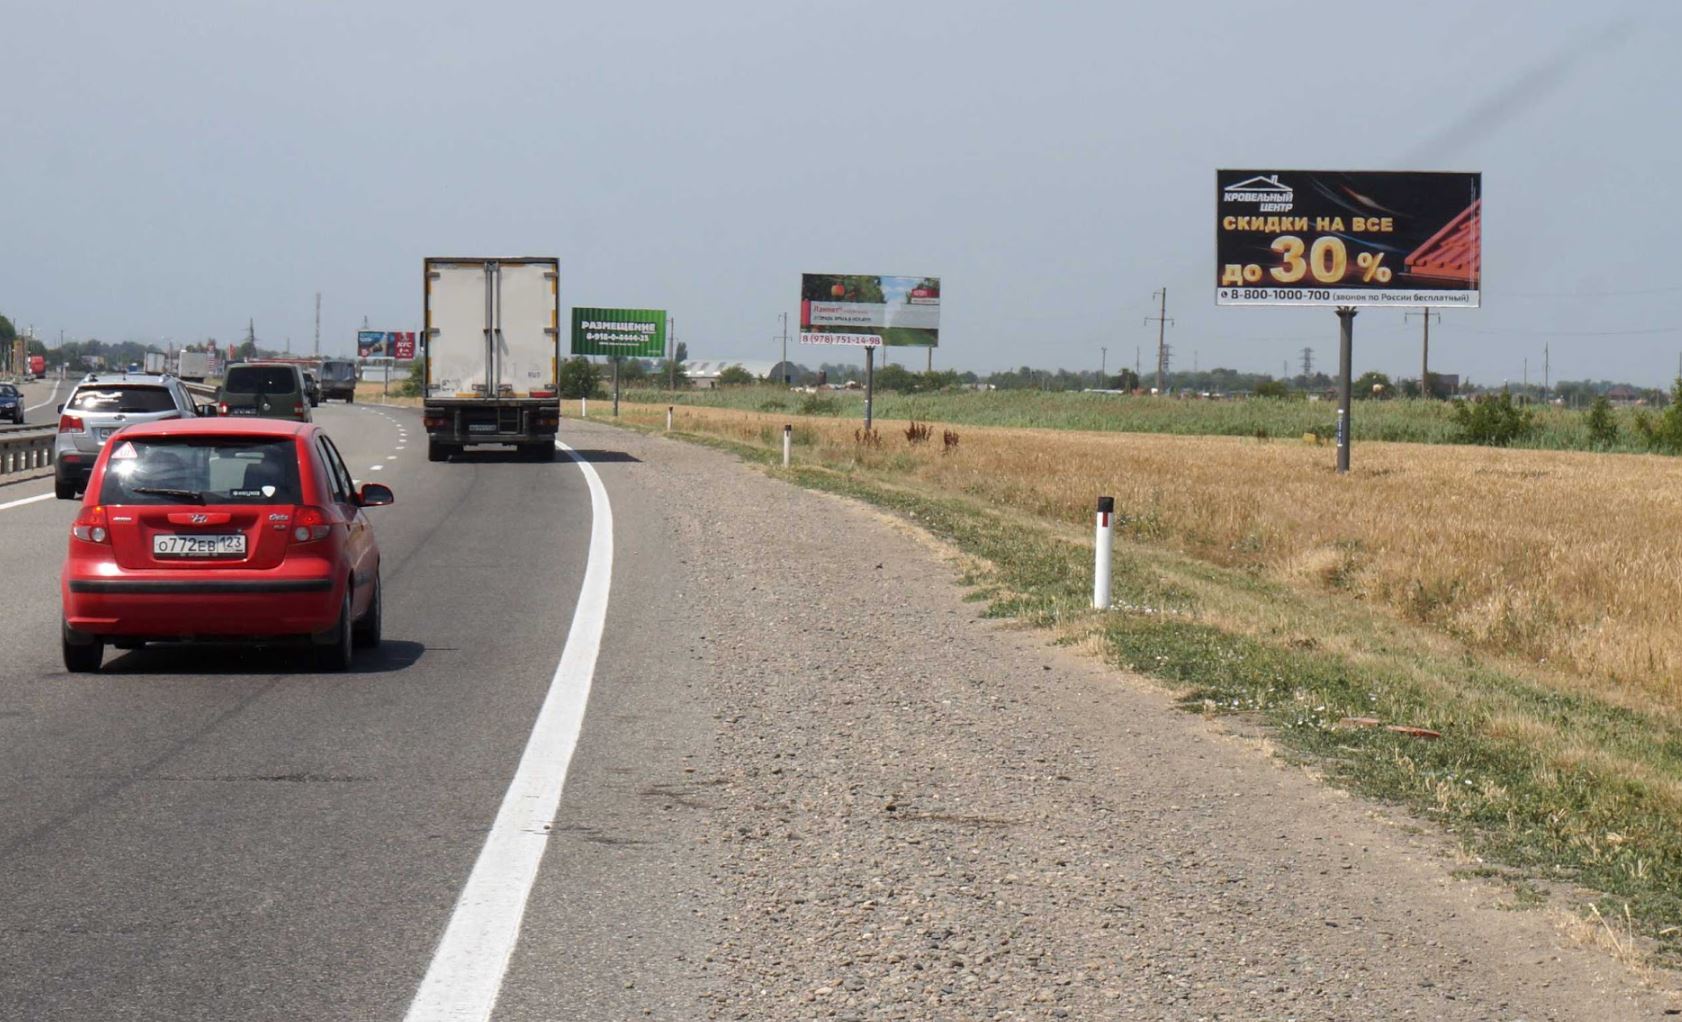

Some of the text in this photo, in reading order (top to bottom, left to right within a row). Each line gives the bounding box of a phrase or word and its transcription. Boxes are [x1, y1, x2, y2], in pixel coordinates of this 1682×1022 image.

[1224, 191, 1293, 202] КРОВЕЛЬНЫЙ
[1259, 203, 1293, 212] ЦЕНТР
[1223, 216, 1393, 233] СКИДКИ НА ВСЕ
[1269, 235, 1347, 283] 30
[1357, 252, 1392, 283] %
[1231, 289, 1330, 300] 8-800-1000-700
[1381, 293, 1412, 302] России
[581, 321, 656, 332] РАЗМЕЩЕНИЕ
[220, 536, 242, 548] 123
